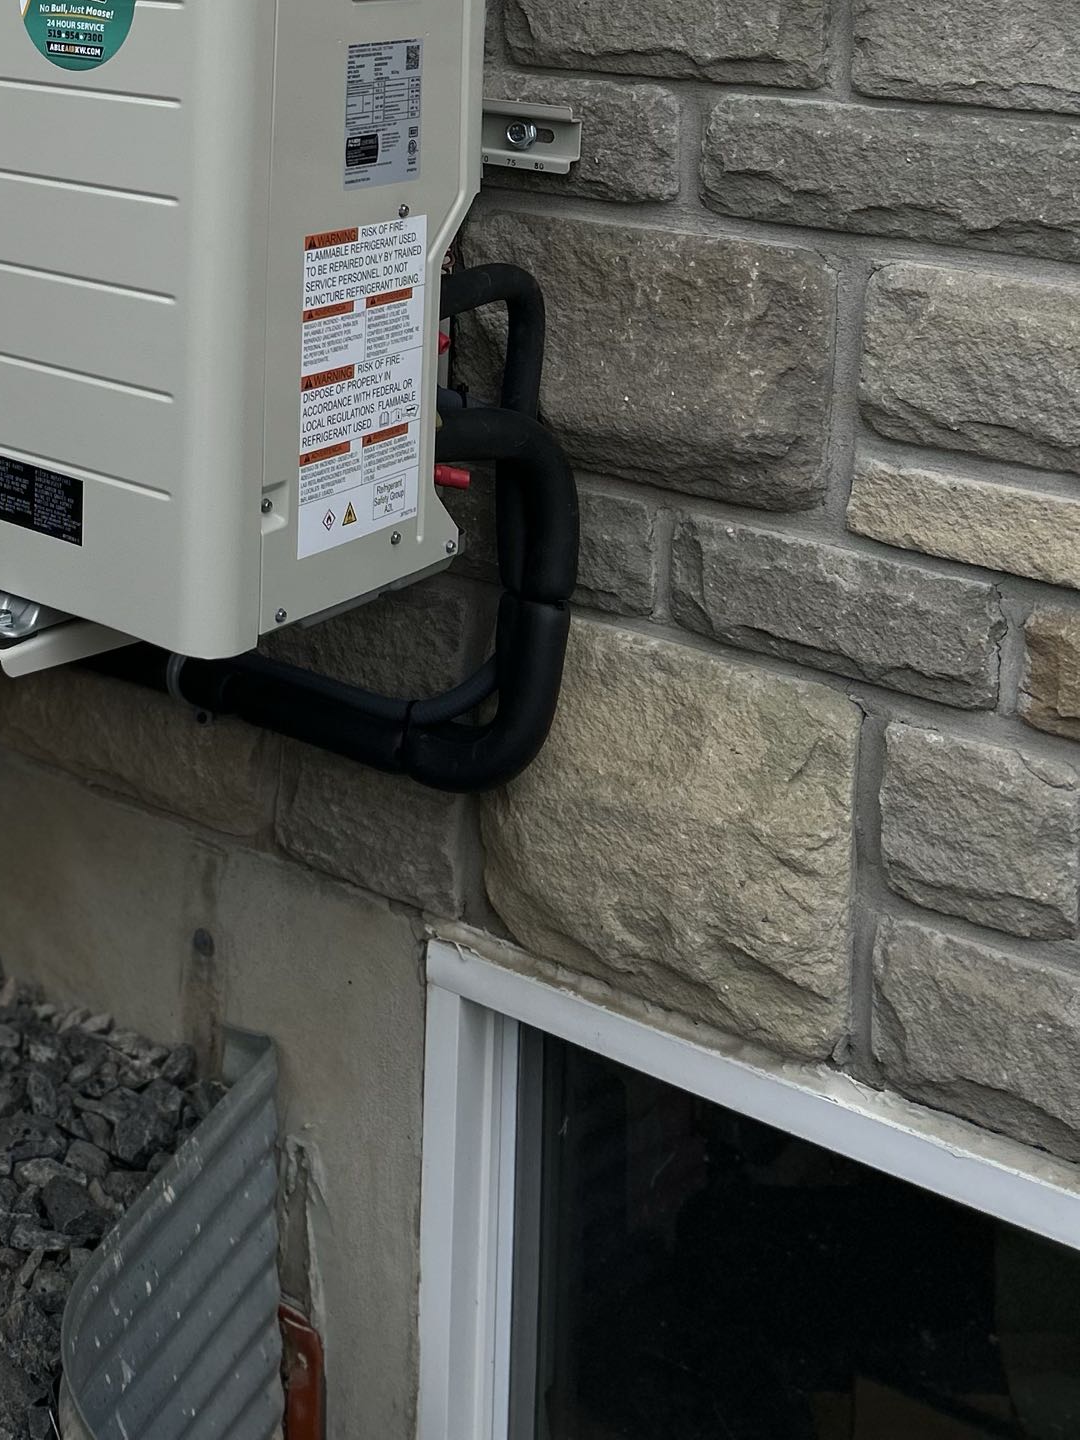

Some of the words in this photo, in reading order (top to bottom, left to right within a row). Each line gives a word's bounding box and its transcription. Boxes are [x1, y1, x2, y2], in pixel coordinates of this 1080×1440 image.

[39, 4, 50, 12] No
[51, 4, 67, 14] Bull,
[69, 5, 84, 14] Just
[85, 6, 114, 19] Moose!
[47, 19, 55, 27] 24
[56, 20, 75, 29] HOUR
[77, 22, 105, 32] SERVICE
[506, 158, 516, 166] 75
[534, 162, 544, 170] 80
[317, 229, 356, 246] WARNING
[361, 226, 378, 238] RISK
[379, 224, 388, 235] OF
[389, 221, 404, 232] FIRE
[306, 245, 349, 263] FLAMMABLE
[350, 236, 397, 254] REFRIGERANT
[306, 266, 316, 278] TO
[317, 264, 327, 276] BE
[329, 257, 364, 273] REPAIRED
[365, 252, 383, 266] ONLY
[384, 251, 393, 262] BY
[394, 245, 422, 259] TRAINED
[305, 276, 337, 293] SERVICE
[383, 265, 393, 276] DO
[394, 262, 408, 273] NOT
[305, 289, 345, 307] PUNCTURE
[346, 279, 393, 298] REFRIGERANT
[313, 366, 353, 386] WARNING
[357, 361, 374, 374] RISK
[375, 359, 384, 370] OF
[385, 354, 401, 367] FIRE
[302, 395, 352, 418] ACCORDANCE
[353, 389, 371, 404] WITH
[372, 382, 402, 399] FEDERAL
[403, 378, 413, 390] OR
[303, 385, 335, 404] DISPOSE
[336, 382, 346, 394] OF
[347, 372, 383, 391] PROPERLY
[384, 370, 391, 381] IN
[302, 417, 325, 434] LOCAL
[378, 390, 416, 411] FLAMMABLE
[302, 424, 352, 448] REFRIGERANT
[373, 494, 389, 508] Safety
[389, 489, 405, 501] Group
[376, 478, 403, 496] Refrigerant
